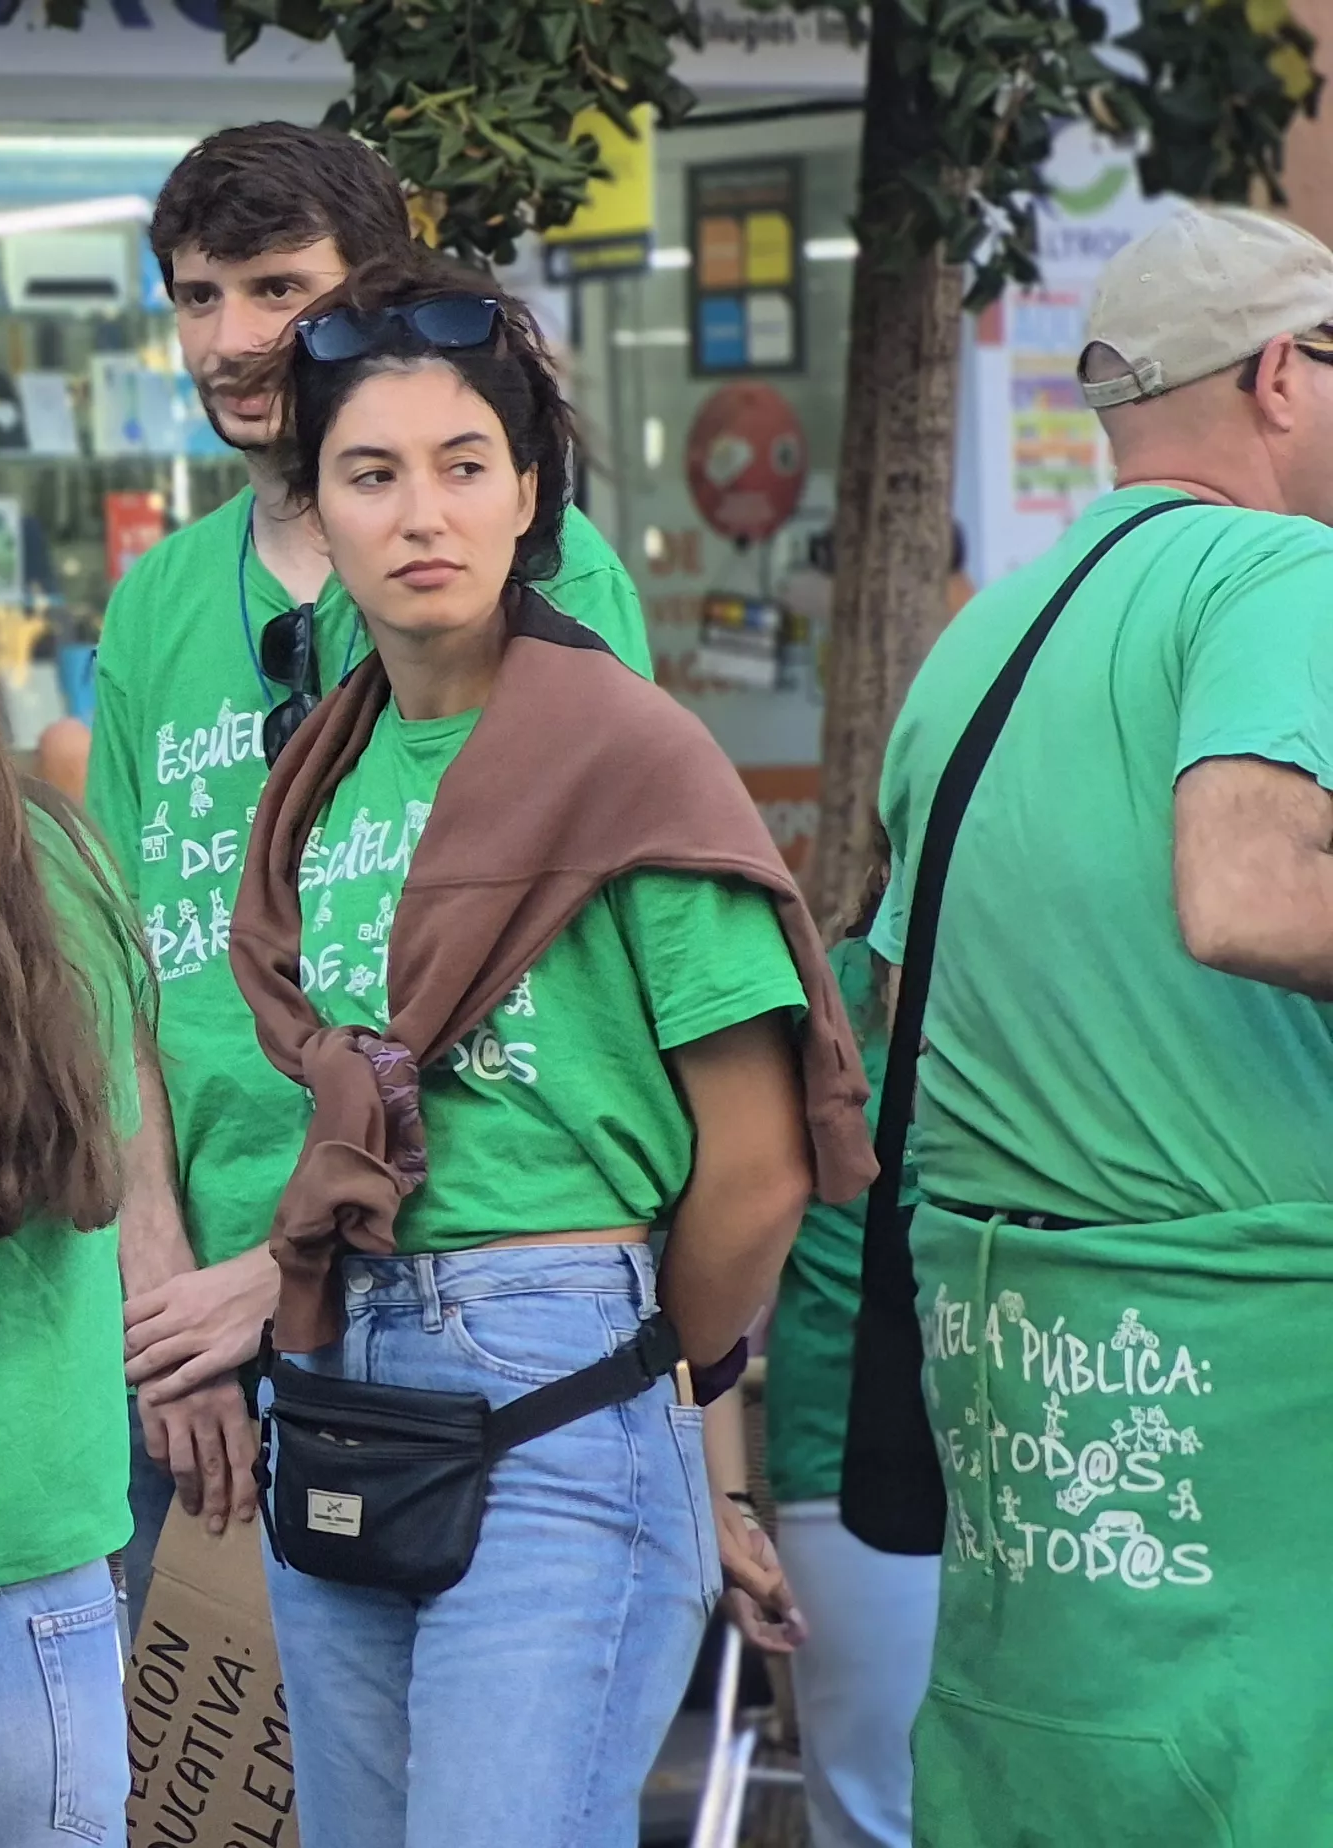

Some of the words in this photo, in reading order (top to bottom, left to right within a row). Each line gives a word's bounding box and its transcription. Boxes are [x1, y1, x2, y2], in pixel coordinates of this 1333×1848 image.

[181, 829, 238, 880] DE
[1019, 1316, 1213, 1396] PÚBLICA:
[1015, 1523, 1213, 1589] TOD@S
